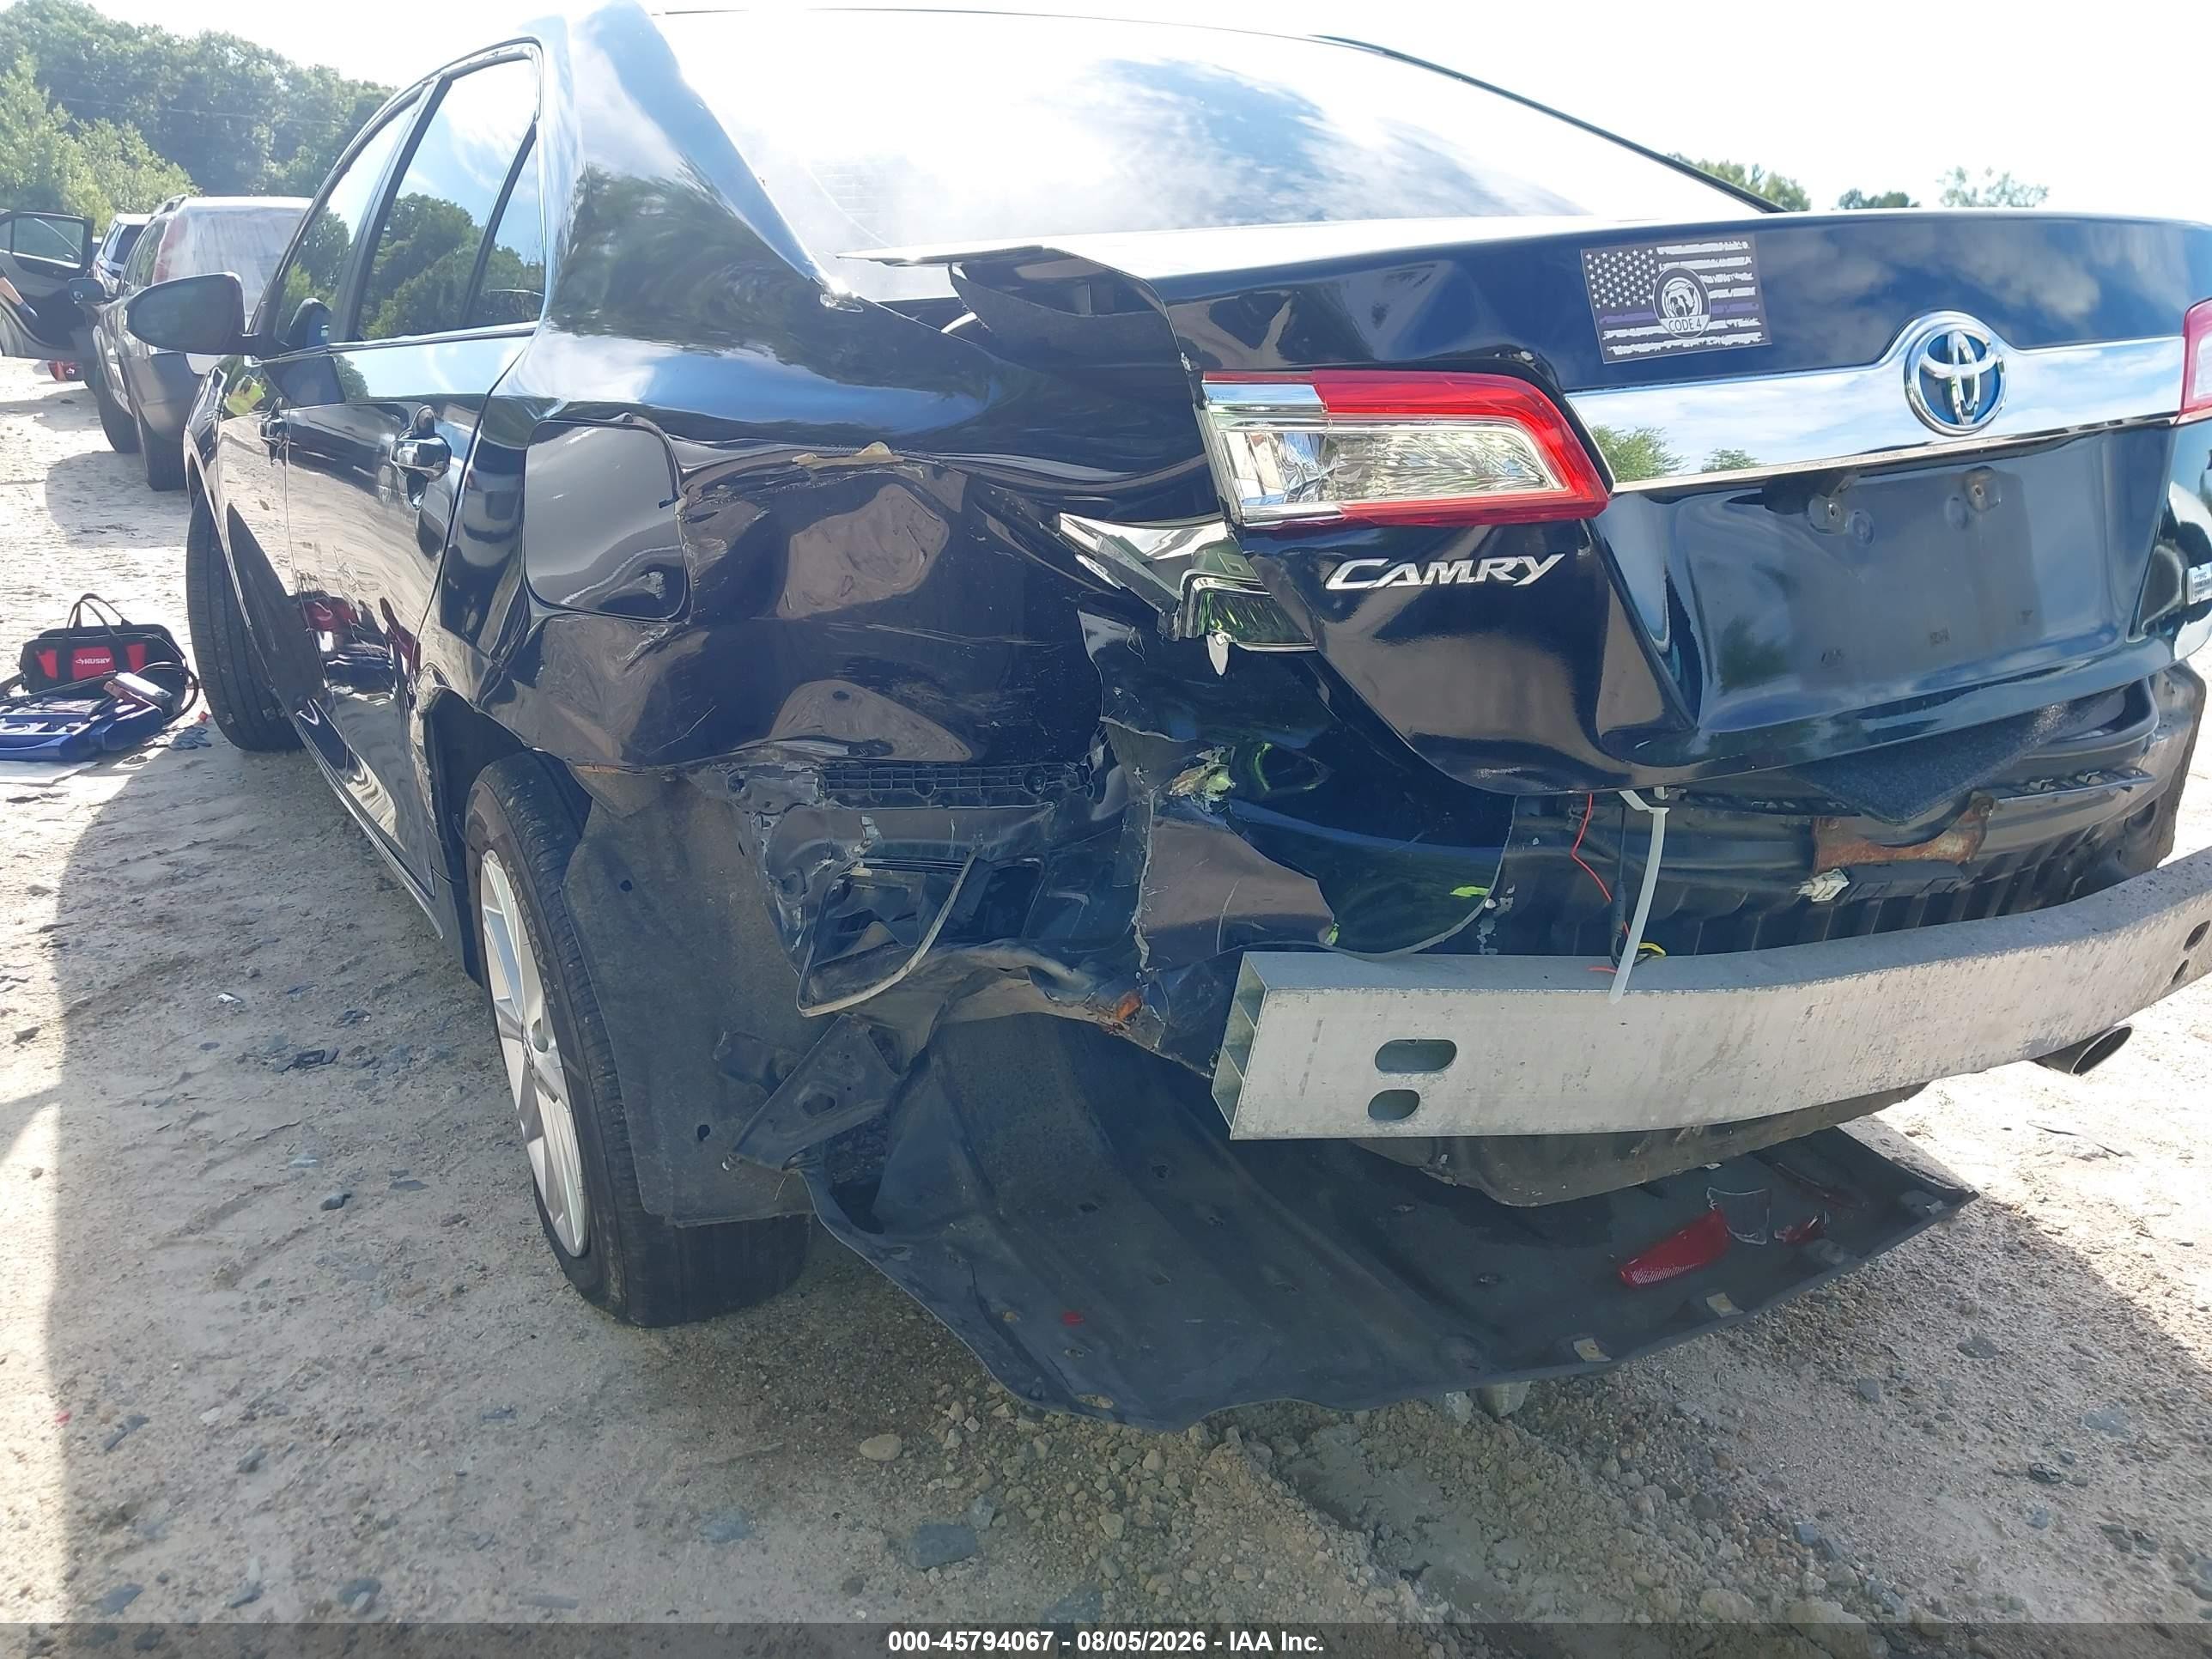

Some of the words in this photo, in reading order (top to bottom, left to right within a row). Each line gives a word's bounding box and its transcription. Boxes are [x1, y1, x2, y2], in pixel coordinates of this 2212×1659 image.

[1669, 319, 1694, 332] CODE
[1696, 316, 1702, 330] 4
[1324, 553, 1566, 590] CAMRY
